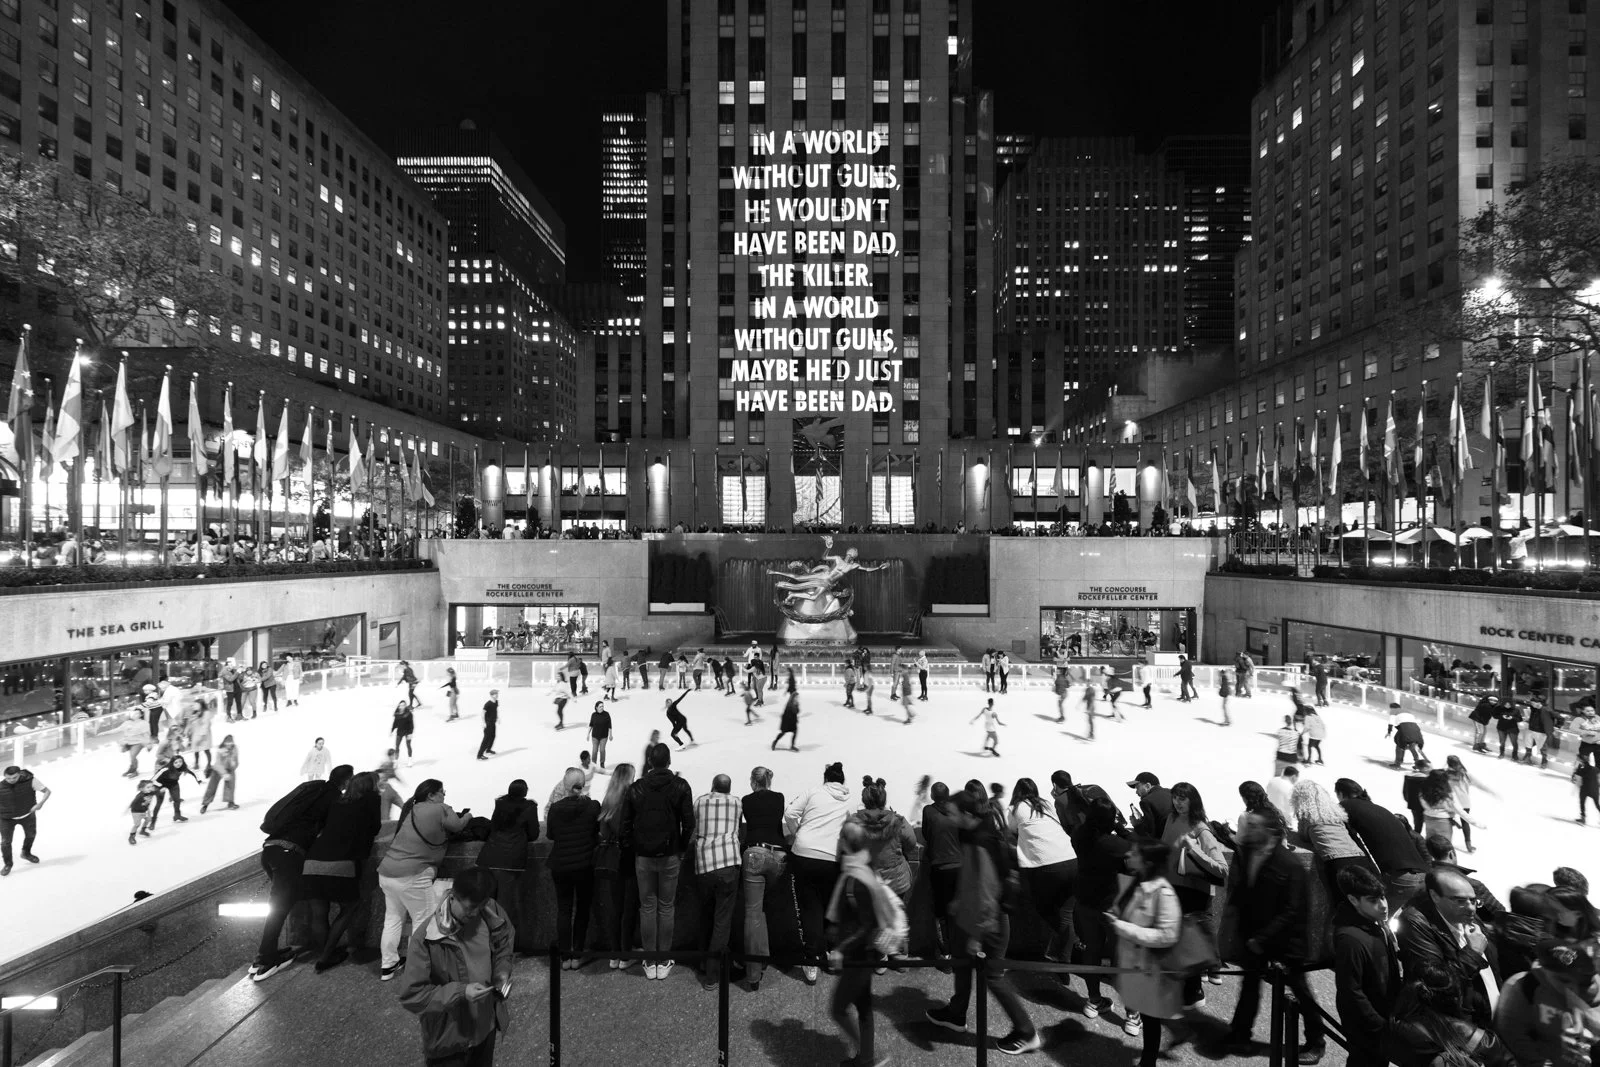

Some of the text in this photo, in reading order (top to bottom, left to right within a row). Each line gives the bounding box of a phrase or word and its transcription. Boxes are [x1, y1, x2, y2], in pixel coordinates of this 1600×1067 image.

[753, 130, 881, 155] IN A WORLD
[732, 164, 900, 191] WITHOUT GUNS,
[744, 197, 889, 223] HE WOULDN'T
[734, 231, 899, 257] HAVE BEEN DAD,
[758, 264, 873, 287] THE KILLER.
[754, 296, 879, 319] IN A WORLD
[734, 328, 830, 351] WITHOUT
[836, 328, 898, 353] GUNS,
[731, 359, 902, 382] MAYBE HE'D JUST
[736, 390, 896, 412] HAVE BEEN DAD.
[66, 620, 164, 639] THE SEA GRILL
[1480, 626, 1515, 638] ROCK
[1518, 630, 1575, 646] CENTER
